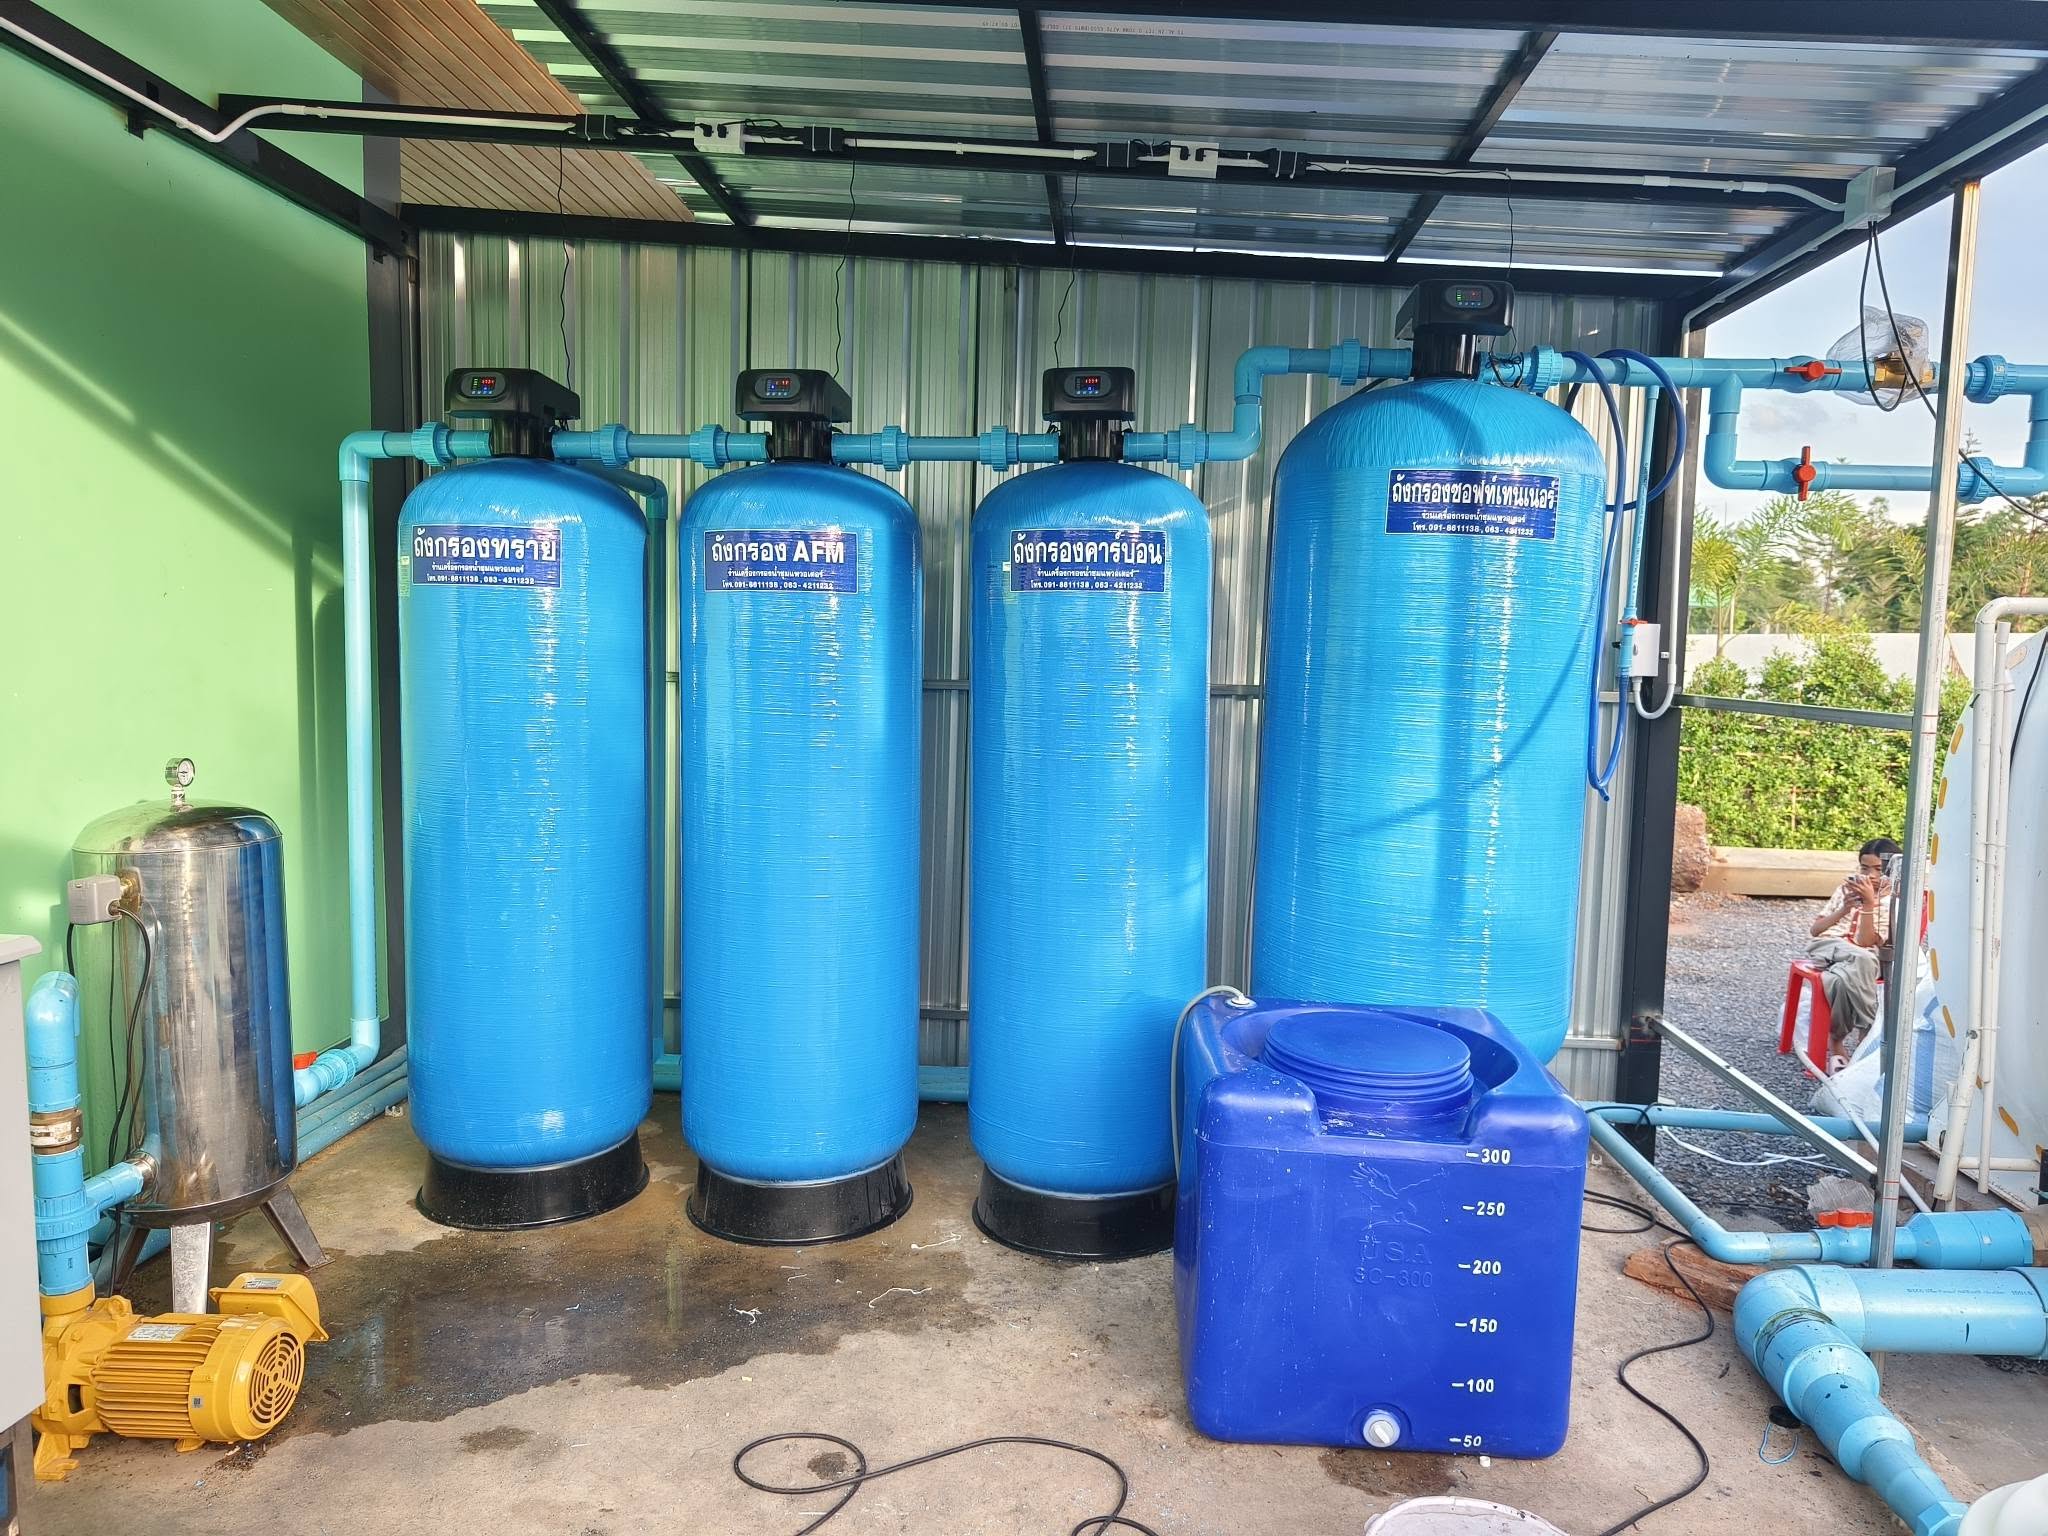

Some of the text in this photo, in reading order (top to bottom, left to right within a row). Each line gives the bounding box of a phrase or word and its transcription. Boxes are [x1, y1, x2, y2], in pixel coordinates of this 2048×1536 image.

[413, 527, 557, 562] ถังกรองทราย
[711, 534, 845, 564] ถังกรอง AFM
[1013, 531, 1163, 564] ถังกรองคาร์บอน
[1480, 1148, 1511, 1165] 300
[1476, 1201, 1506, 1217] 250
[1471, 1259, 1502, 1275] 200
[1469, 1317, 1498, 1333] 150
[1466, 1378, 1495, 1393] 100
[1463, 1434, 1483, 1448] 50
